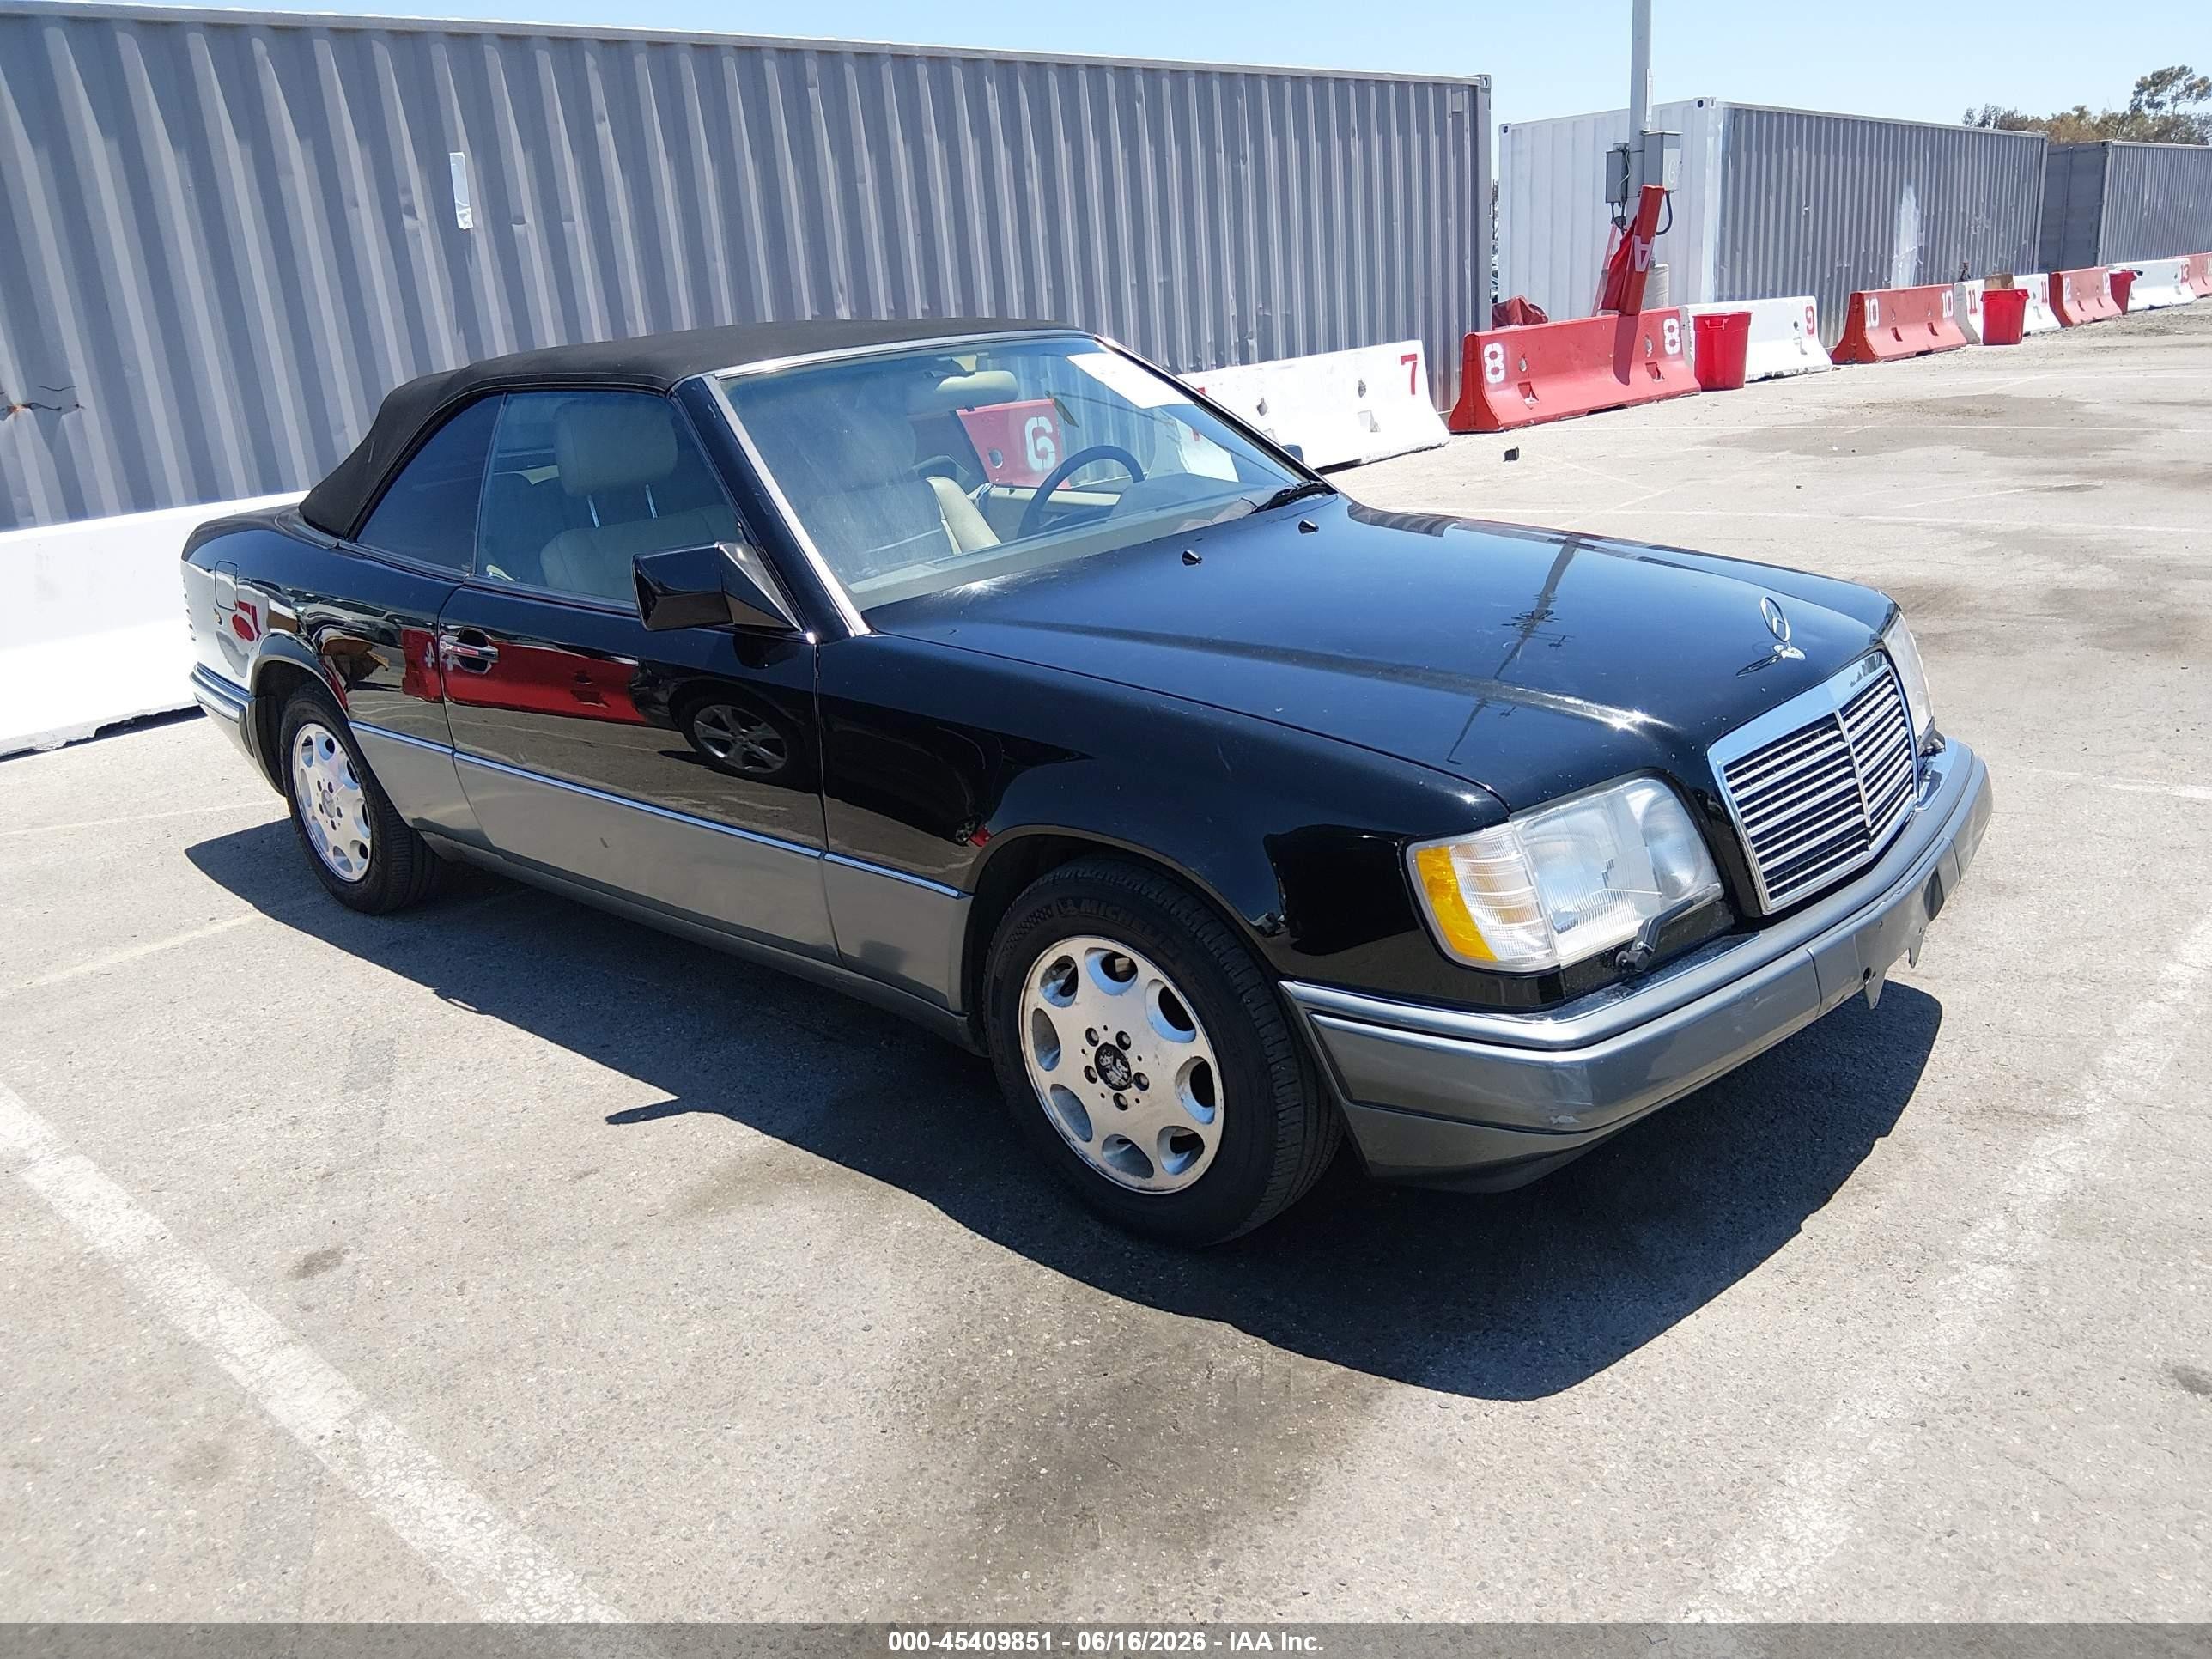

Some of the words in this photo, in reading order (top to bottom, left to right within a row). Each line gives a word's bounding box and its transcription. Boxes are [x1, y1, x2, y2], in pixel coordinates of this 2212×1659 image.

[2180, 264, 2190, 283] 13
[1941, 290, 1954, 318] 10
[1966, 289, 1978, 314] 11
[2040, 281, 2048, 303] 11
[1805, 305, 1815, 335] 9
[1864, 298, 1879, 328] 10
[1663, 318, 1681, 356] 8
[1401, 353, 1418, 396] 7
[1483, 343, 1505, 384] 8
[1024, 416, 1056, 472] 6
